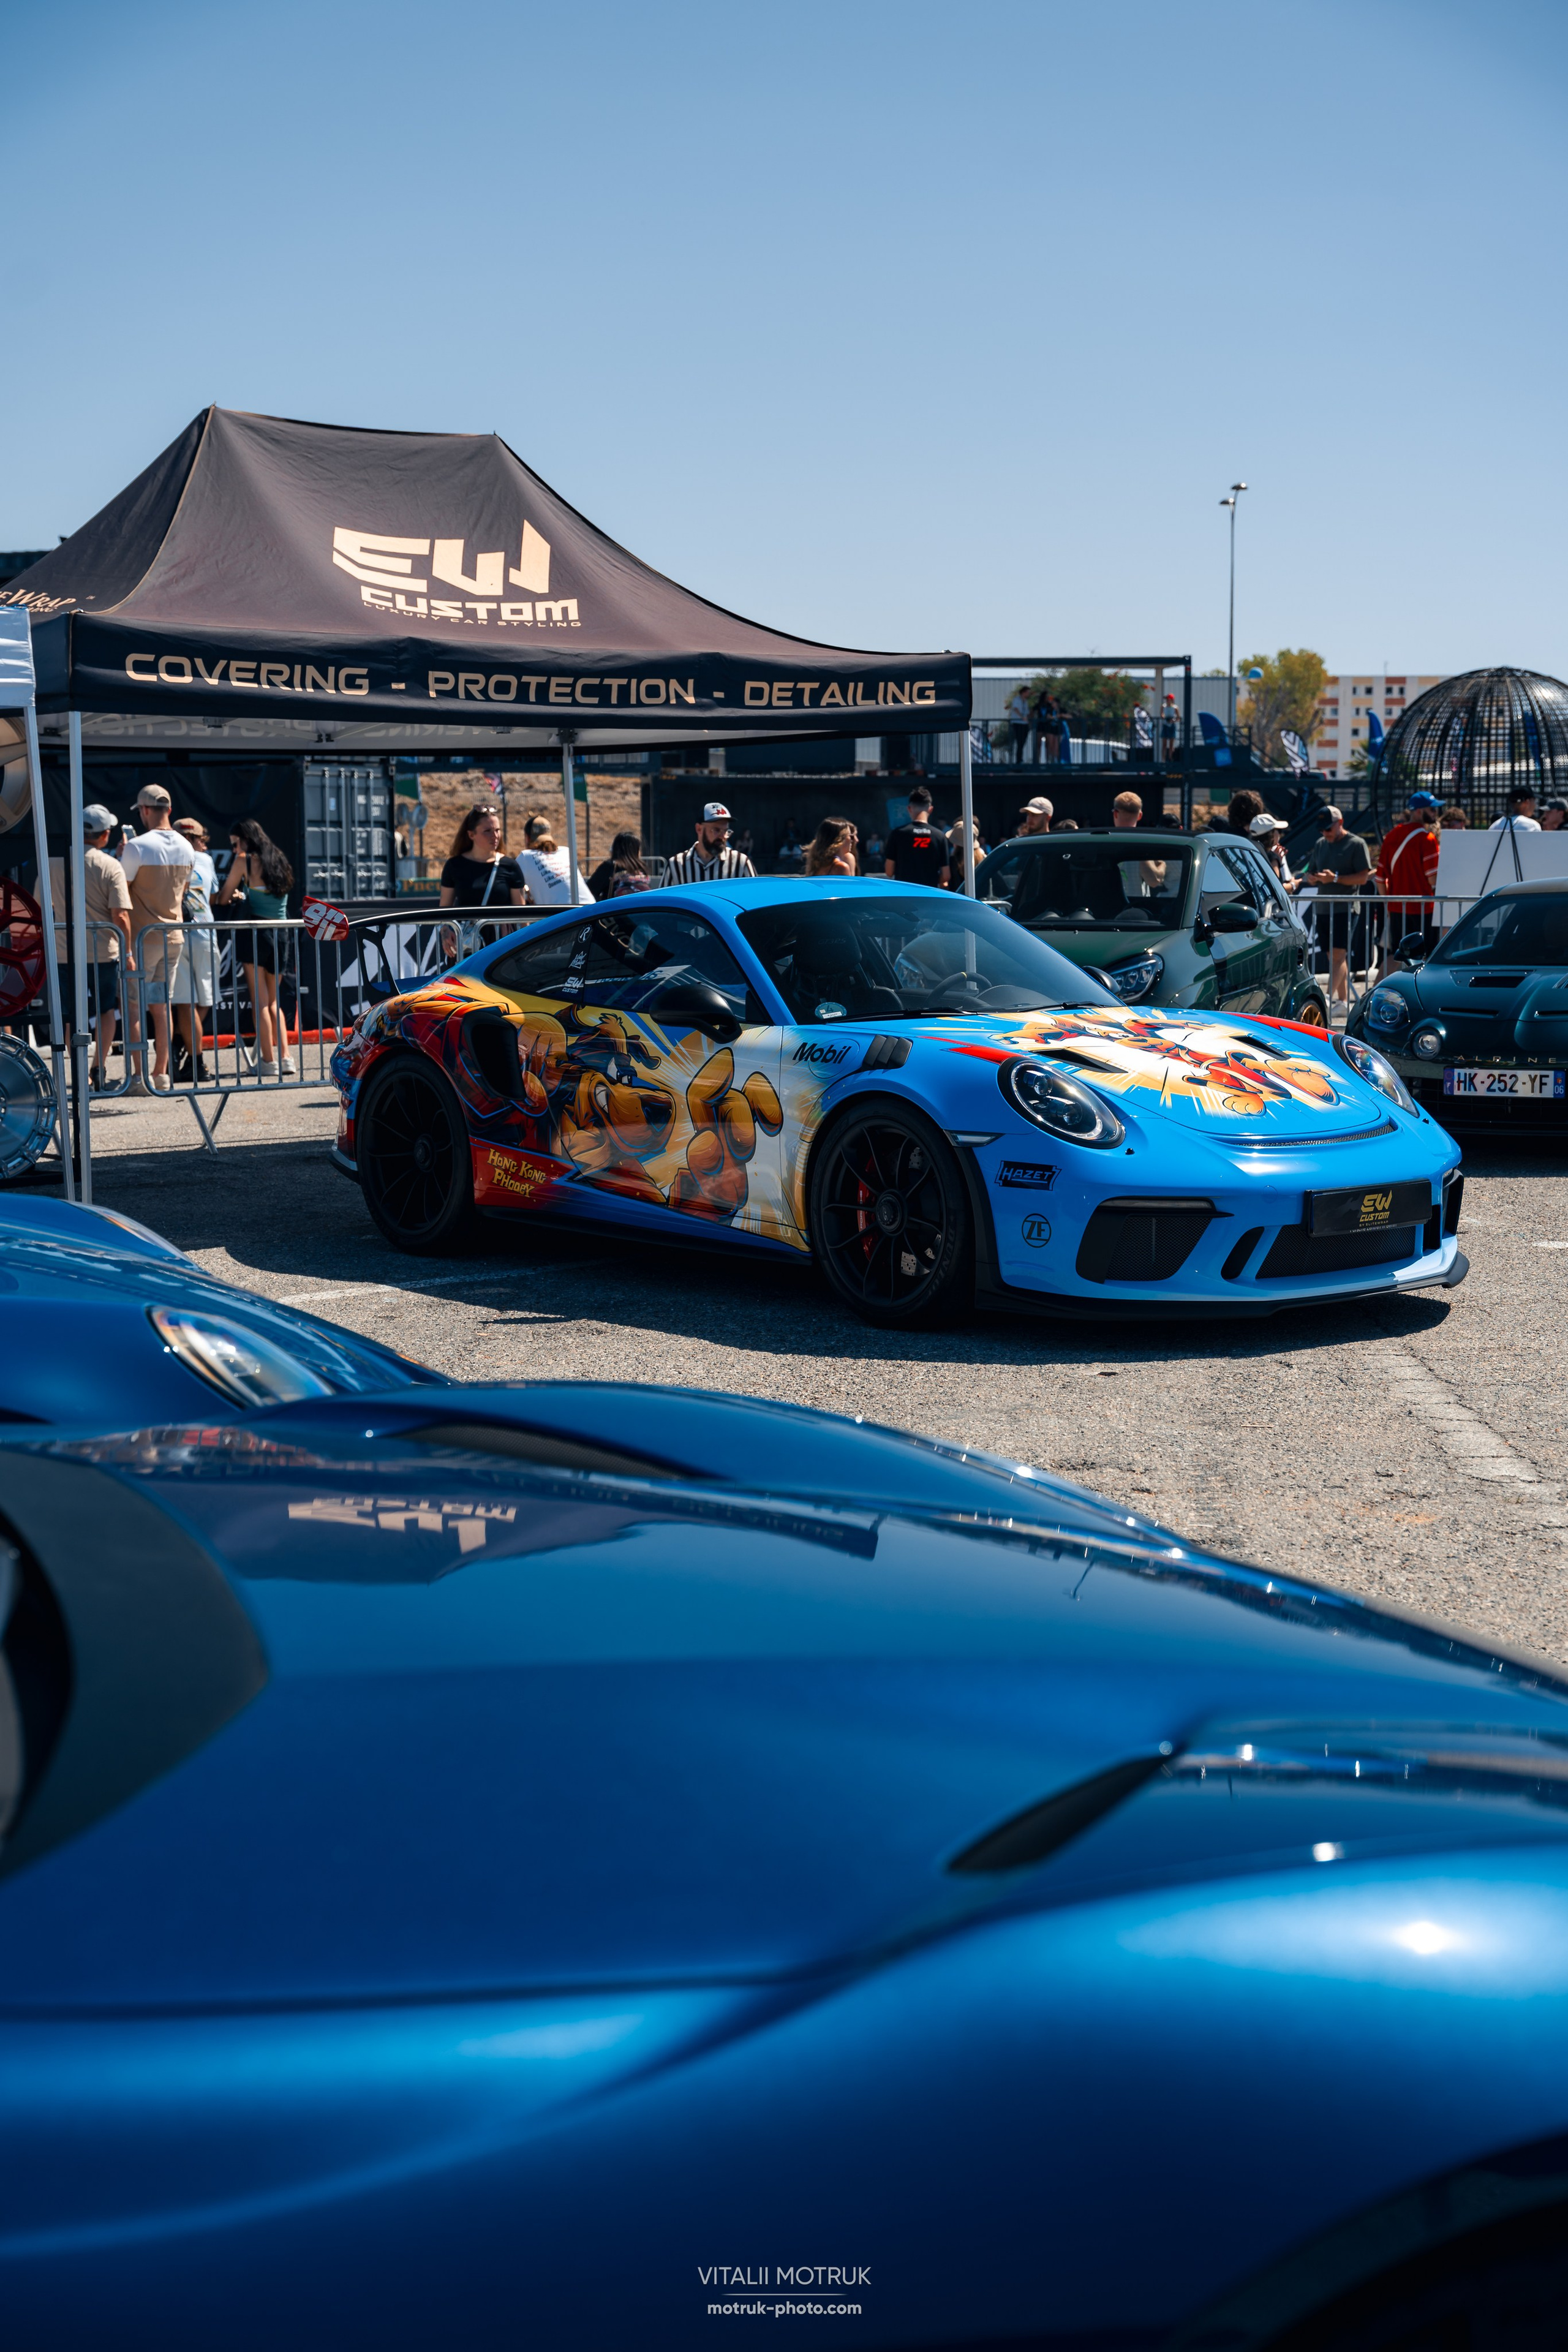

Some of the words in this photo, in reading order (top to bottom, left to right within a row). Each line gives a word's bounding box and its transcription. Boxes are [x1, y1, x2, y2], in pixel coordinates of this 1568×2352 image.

[360, 586, 579, 621] CUSTOM
[363, 601, 440, 620] LUXURY
[125, 653, 369, 696] COVERING
[428, 671, 695, 704] PROTECTION
[744, 680, 936, 707] DETAILING
[913, 837, 931, 848] 72
[579, 926, 590, 941] R
[793, 1042, 852, 1064] Mobil
[1457, 1055, 1556, 1063] ALPINE
[1457, 1072, 1550, 1094] HK-252-YF
[1555, 1085, 1564, 1094] 06
[1001, 1167, 1052, 1181] HAZET
[1359, 1212, 1390, 1222] CUSTOM
[1023, 1219, 1050, 1243] ZF
